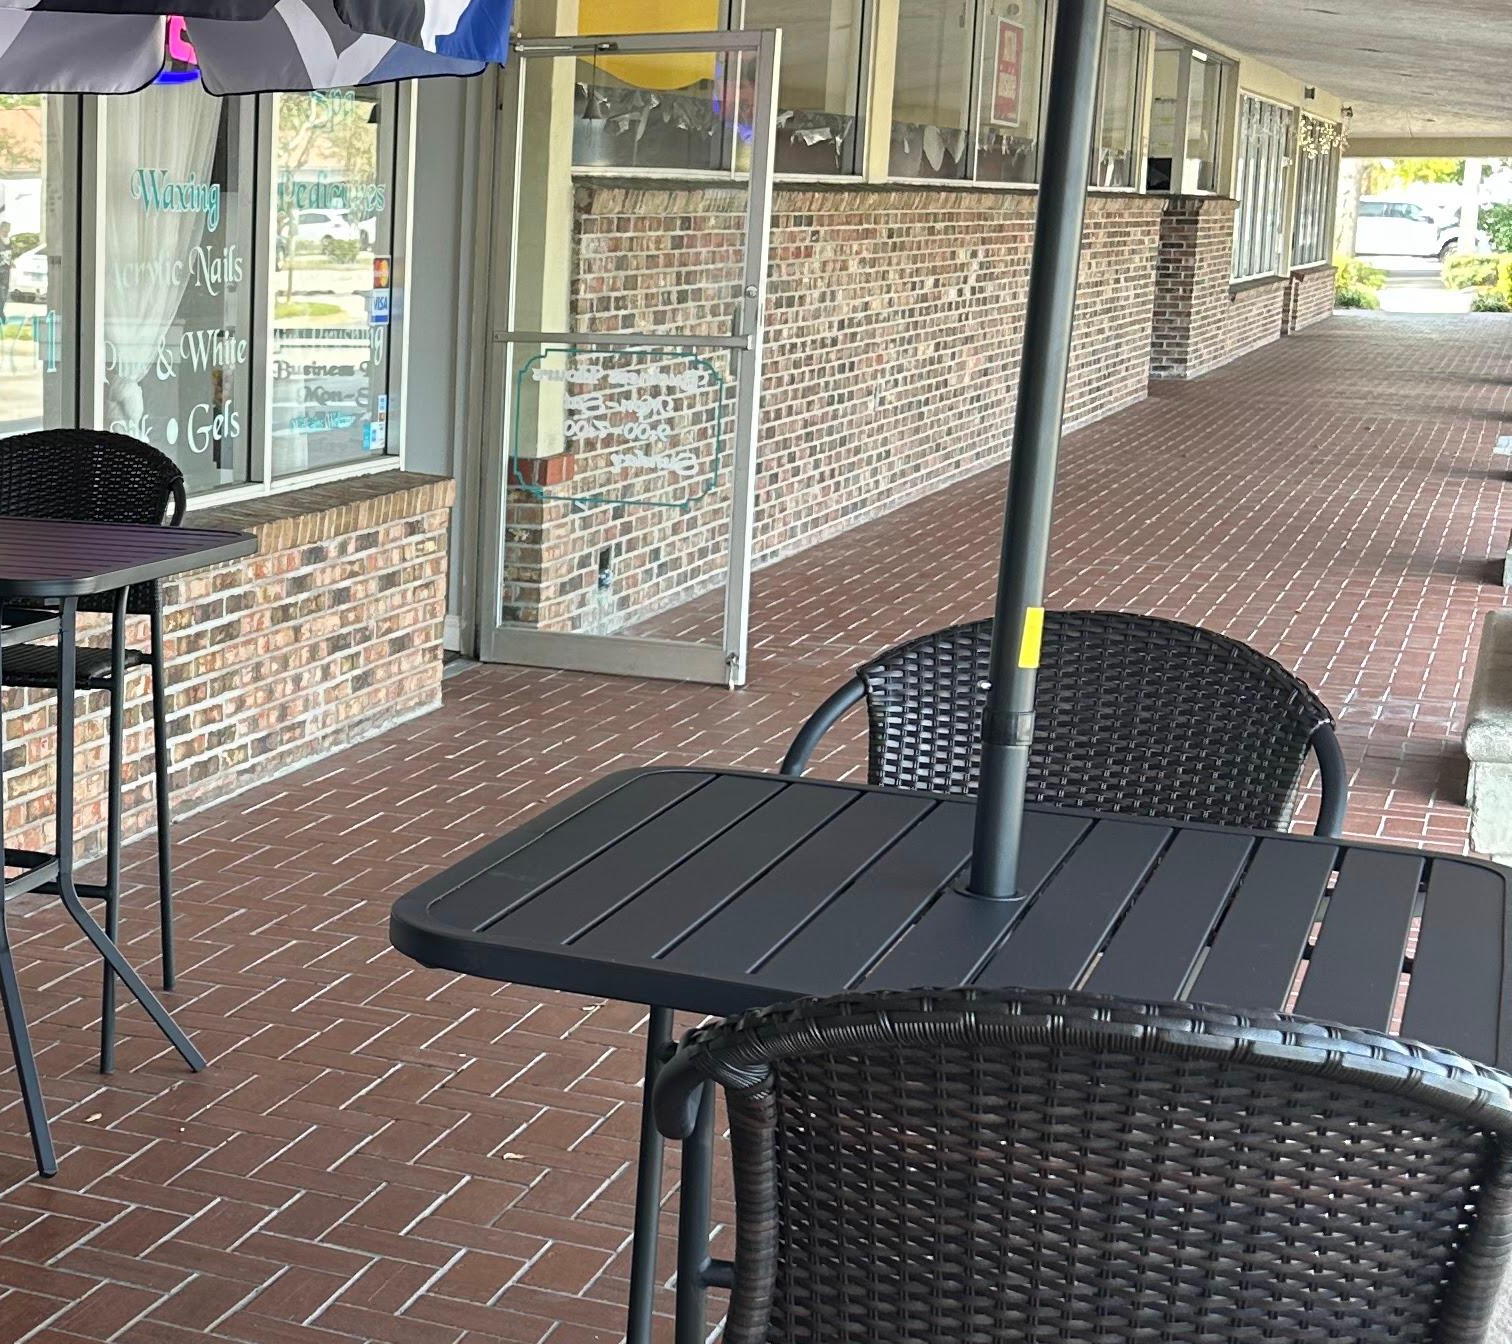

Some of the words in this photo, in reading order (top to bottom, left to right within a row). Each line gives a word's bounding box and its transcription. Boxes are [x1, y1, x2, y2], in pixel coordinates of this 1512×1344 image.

[130, 168, 220, 232] Waxing
[189, 245, 243, 296] Nails
[156, 335, 176, 380] &
[180, 329, 248, 374] White
[187, 400, 241, 454] Gels
